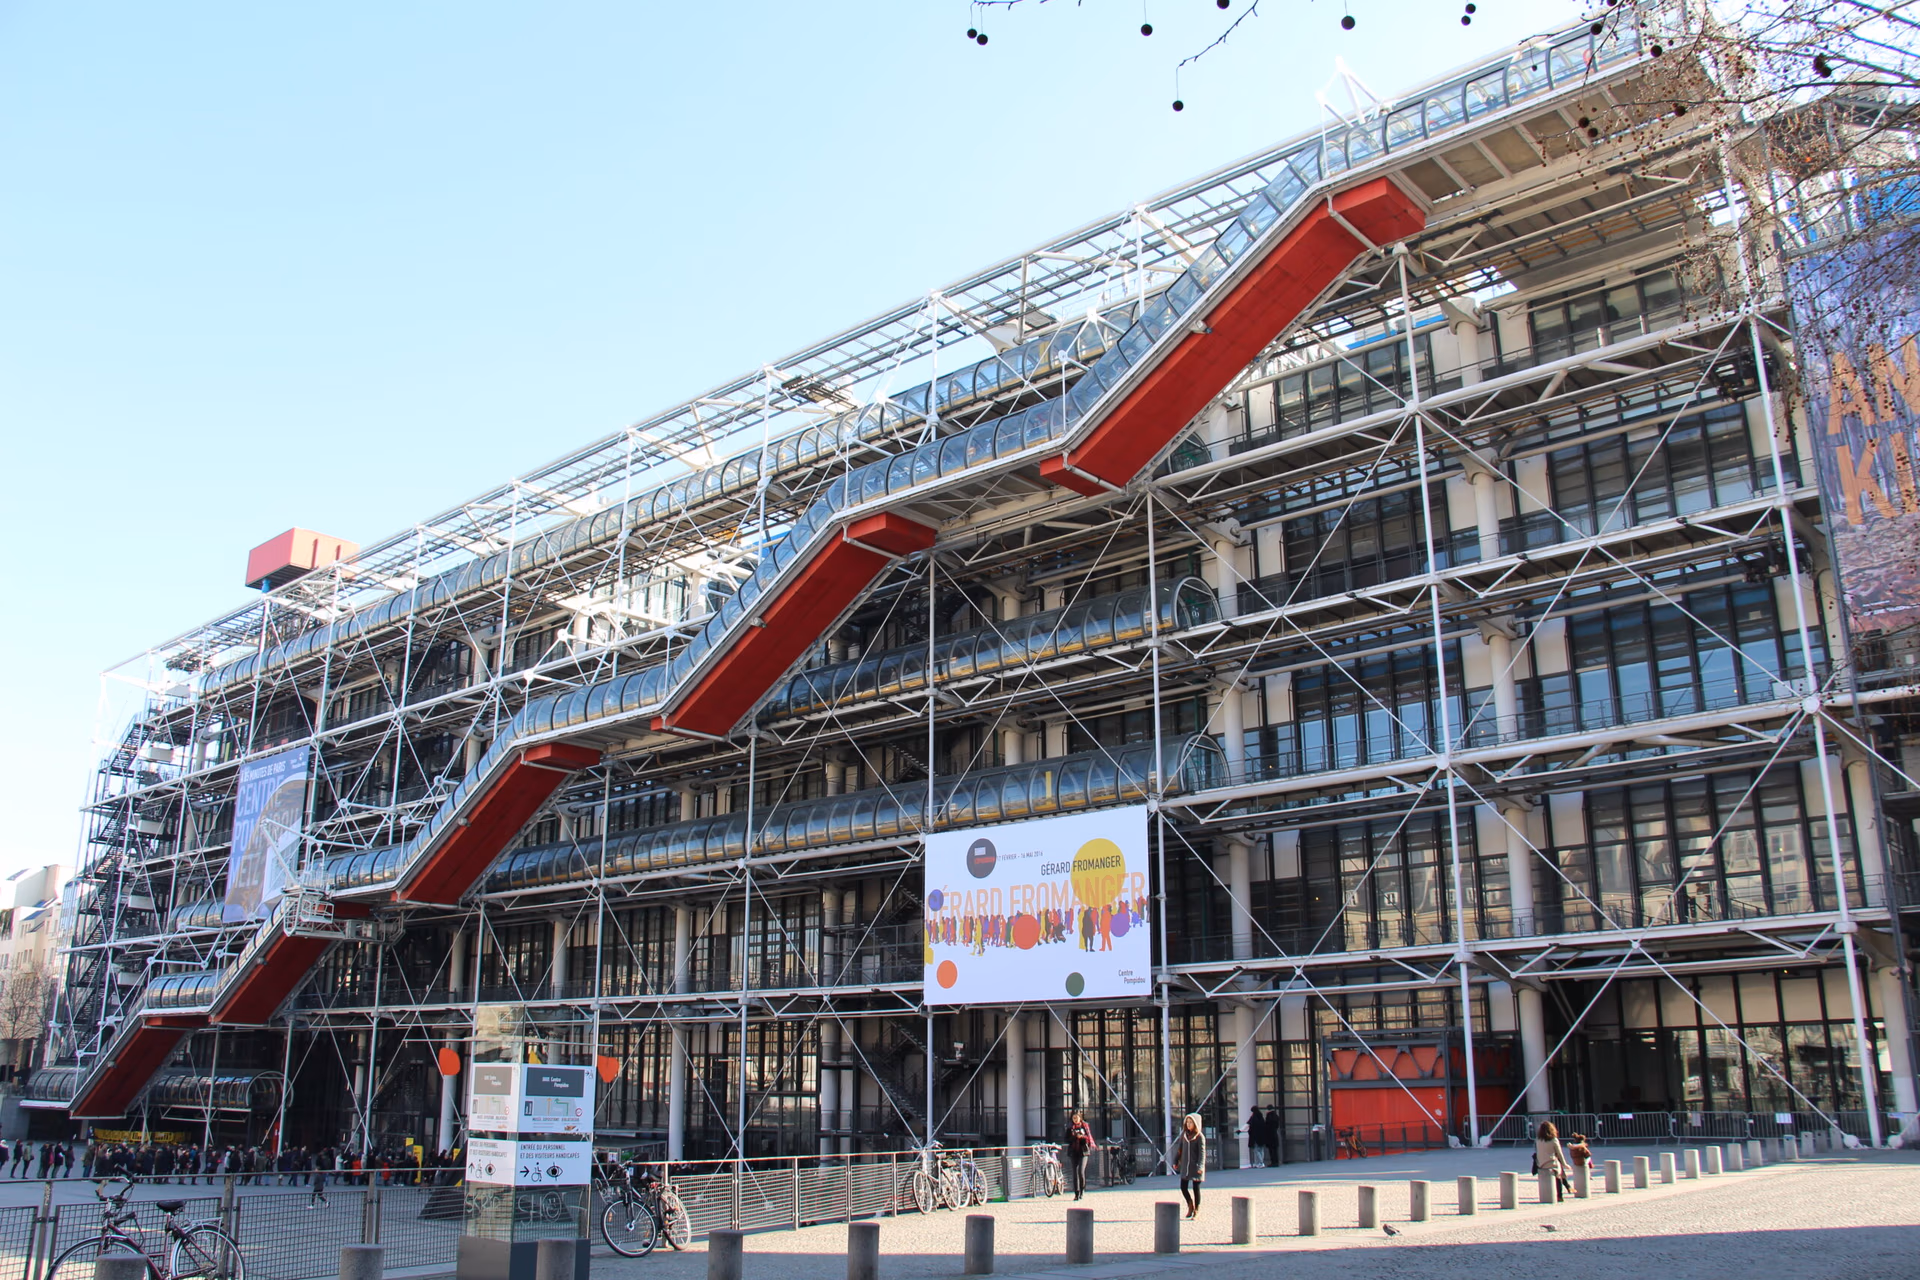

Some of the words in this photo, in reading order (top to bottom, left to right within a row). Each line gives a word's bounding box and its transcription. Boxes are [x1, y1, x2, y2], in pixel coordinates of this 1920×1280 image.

[249, 766, 267, 780] MINUTES
[267, 764, 273, 776] DE
[273, 760, 286, 774] PARIS
[1002, 852, 1017, 861] FÉVRIER
[1041, 860, 1071, 876] GÉRARD
[1073, 855, 1121, 872] FROMANGER
[1010, 871, 1145, 917] FROMANGER
[1124, 977, 1146, 985] Pompidou
[556, 1151, 580, 1159] HANDICAPÉS
